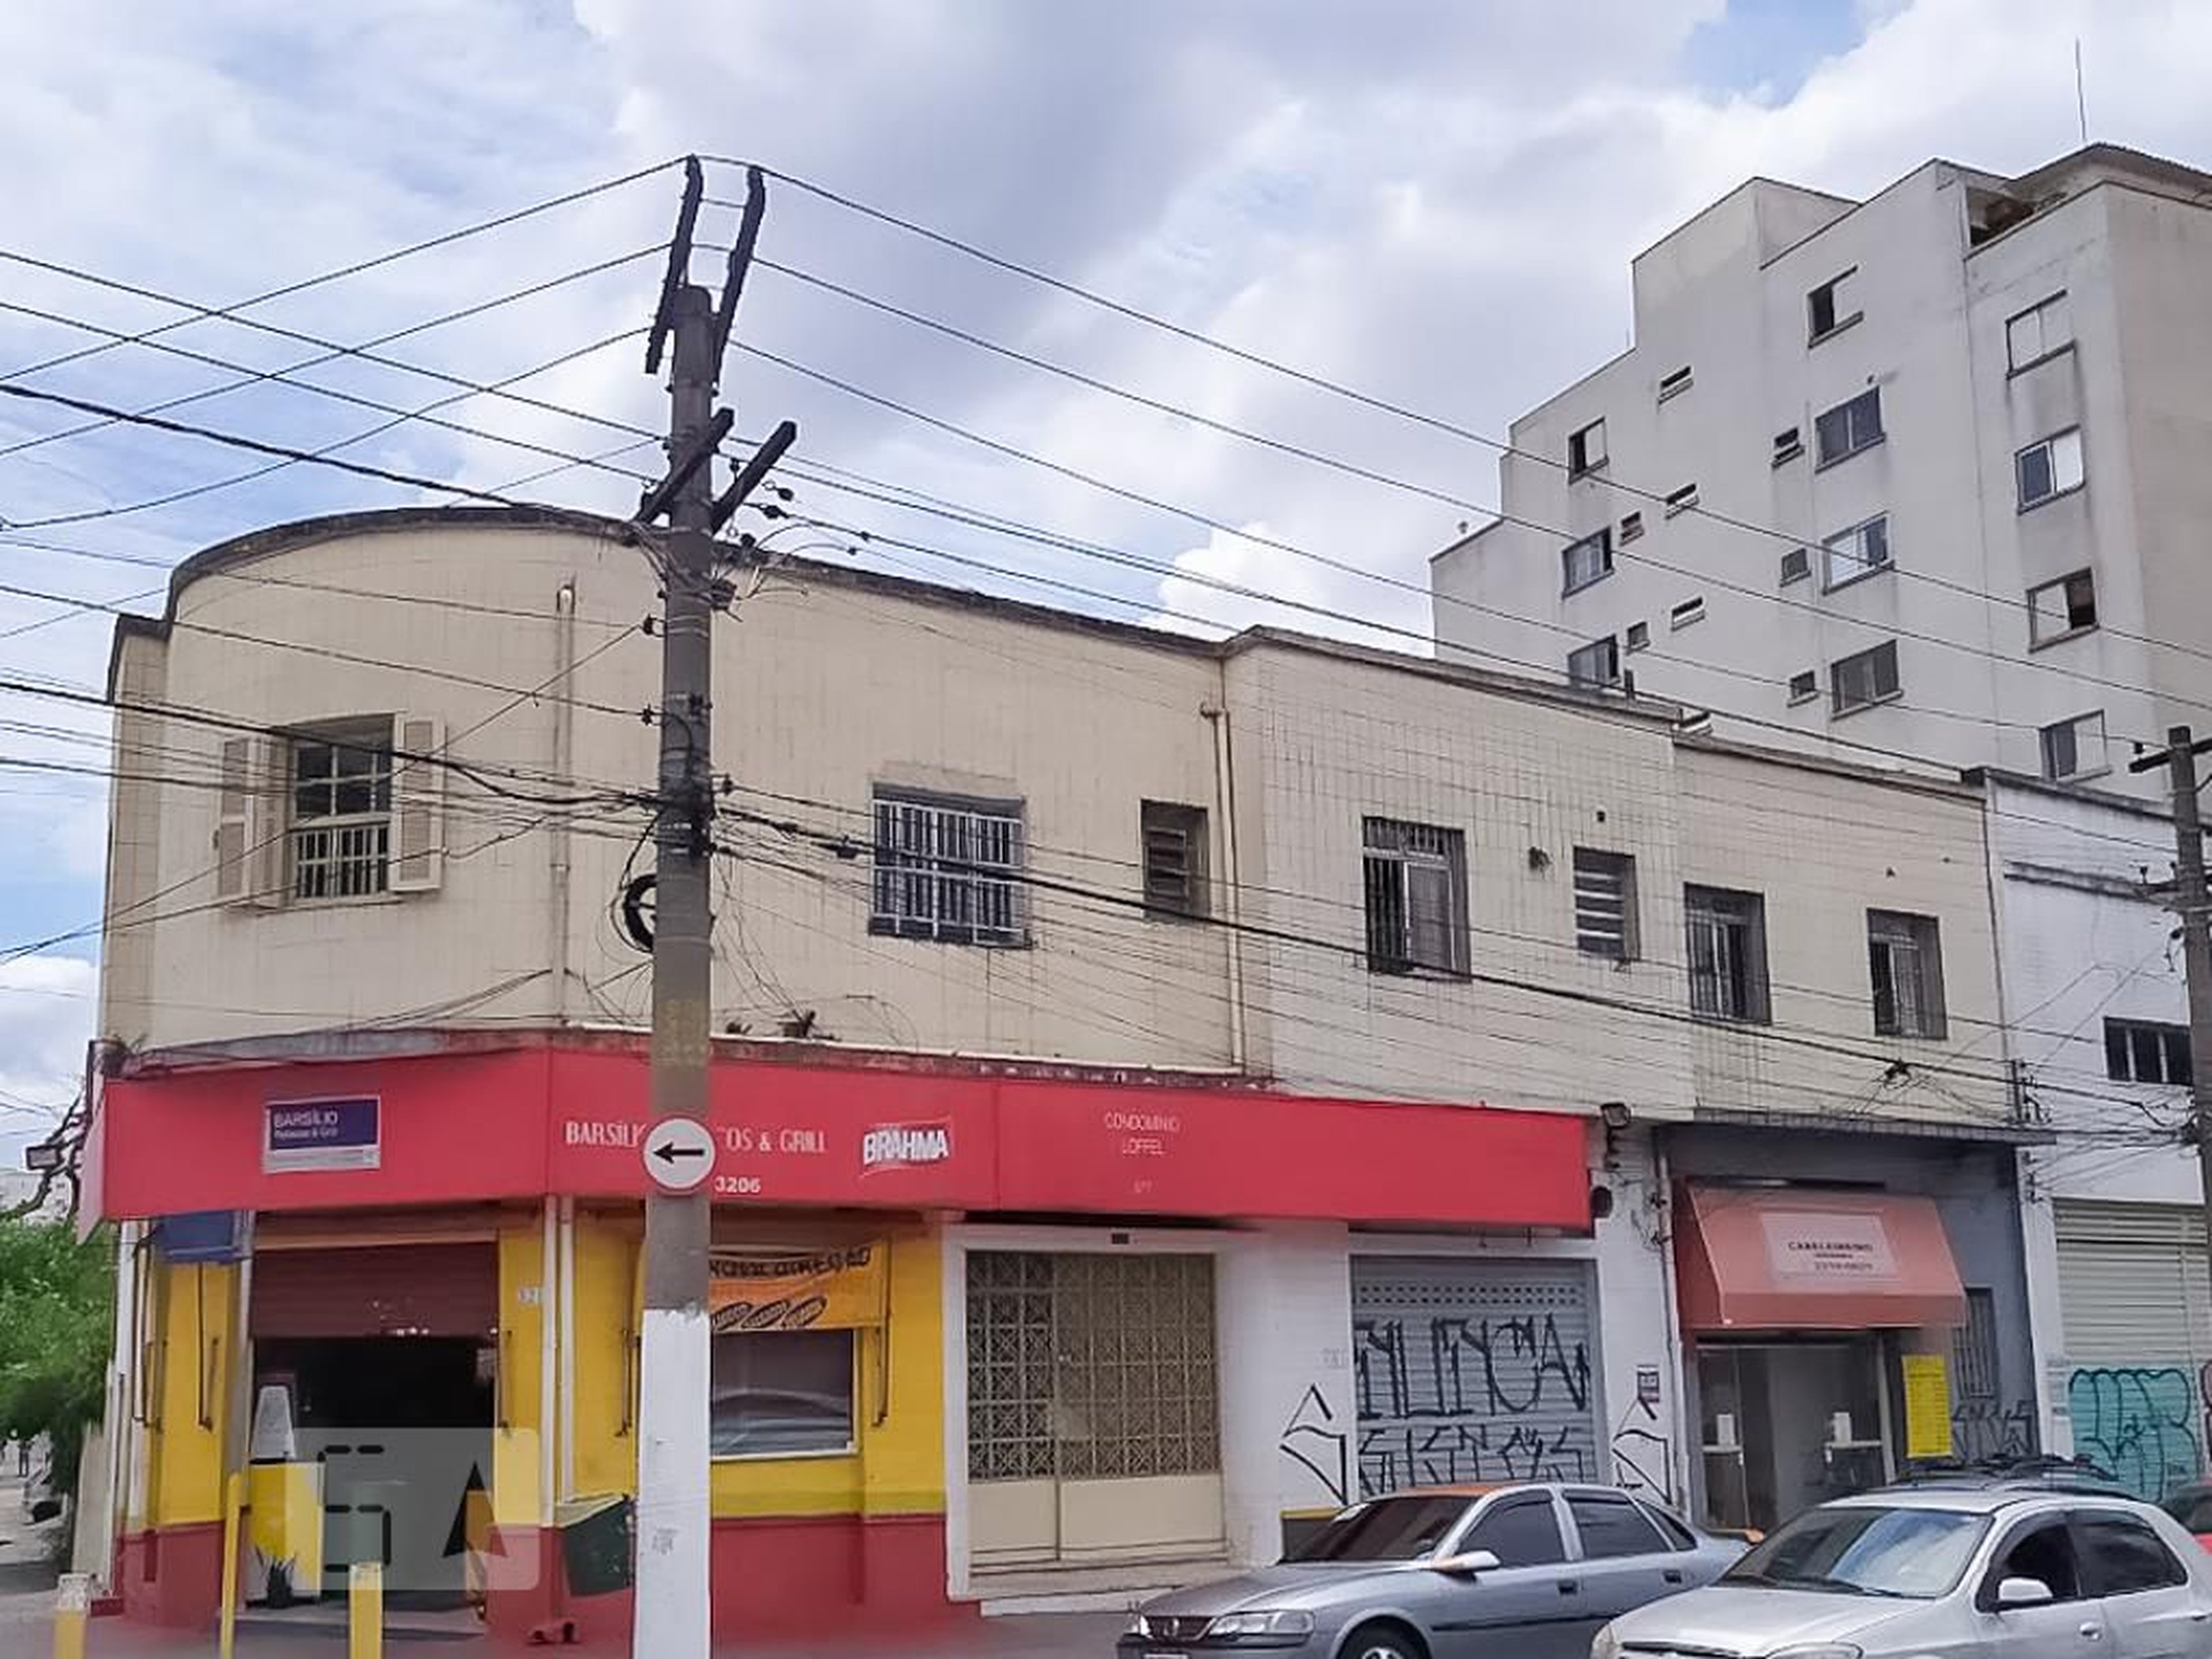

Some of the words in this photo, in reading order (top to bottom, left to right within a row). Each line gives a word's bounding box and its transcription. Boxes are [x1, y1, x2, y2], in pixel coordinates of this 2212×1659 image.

[759, 1131, 771, 1151] &
[779, 1129, 825, 1153] GRILL
[863, 1128, 949, 1166] BRAHMA
